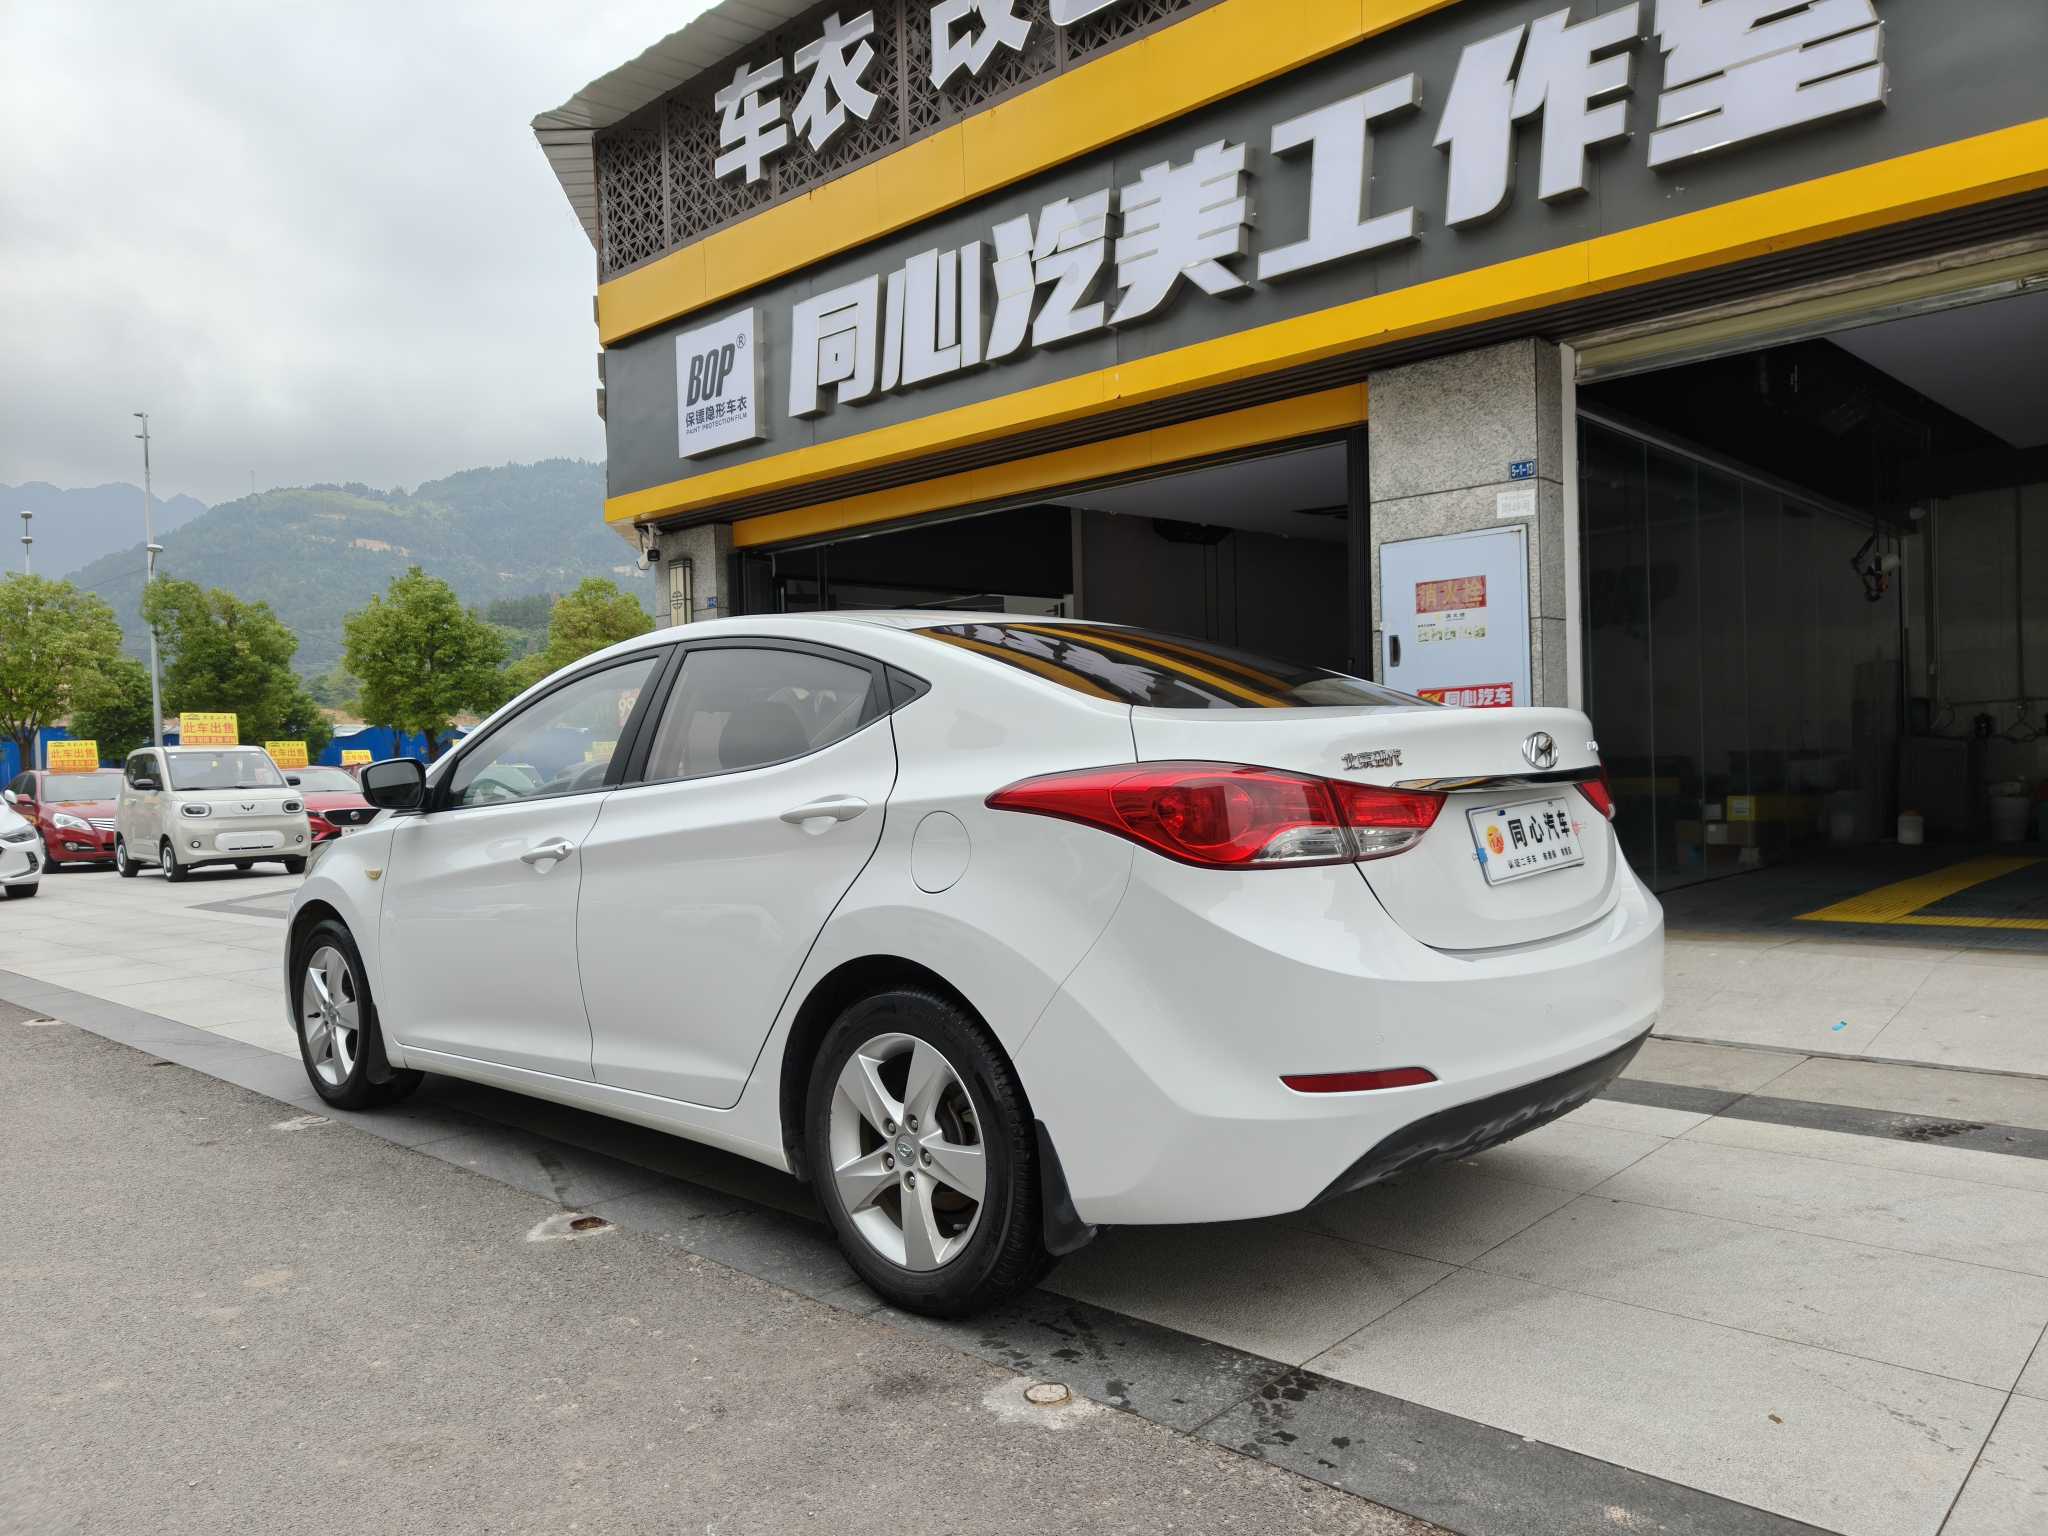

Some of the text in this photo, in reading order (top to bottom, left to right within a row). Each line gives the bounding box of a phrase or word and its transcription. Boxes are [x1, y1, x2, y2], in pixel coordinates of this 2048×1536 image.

[713, 9, 878, 185] 车衣
[787, 0, 1885, 418] 同心汽美工作室
[702, 417, 735, 432] PROTECTION
[735, 413, 748, 424] FILM
[1507, 809, 1571, 849] 同心汽车
